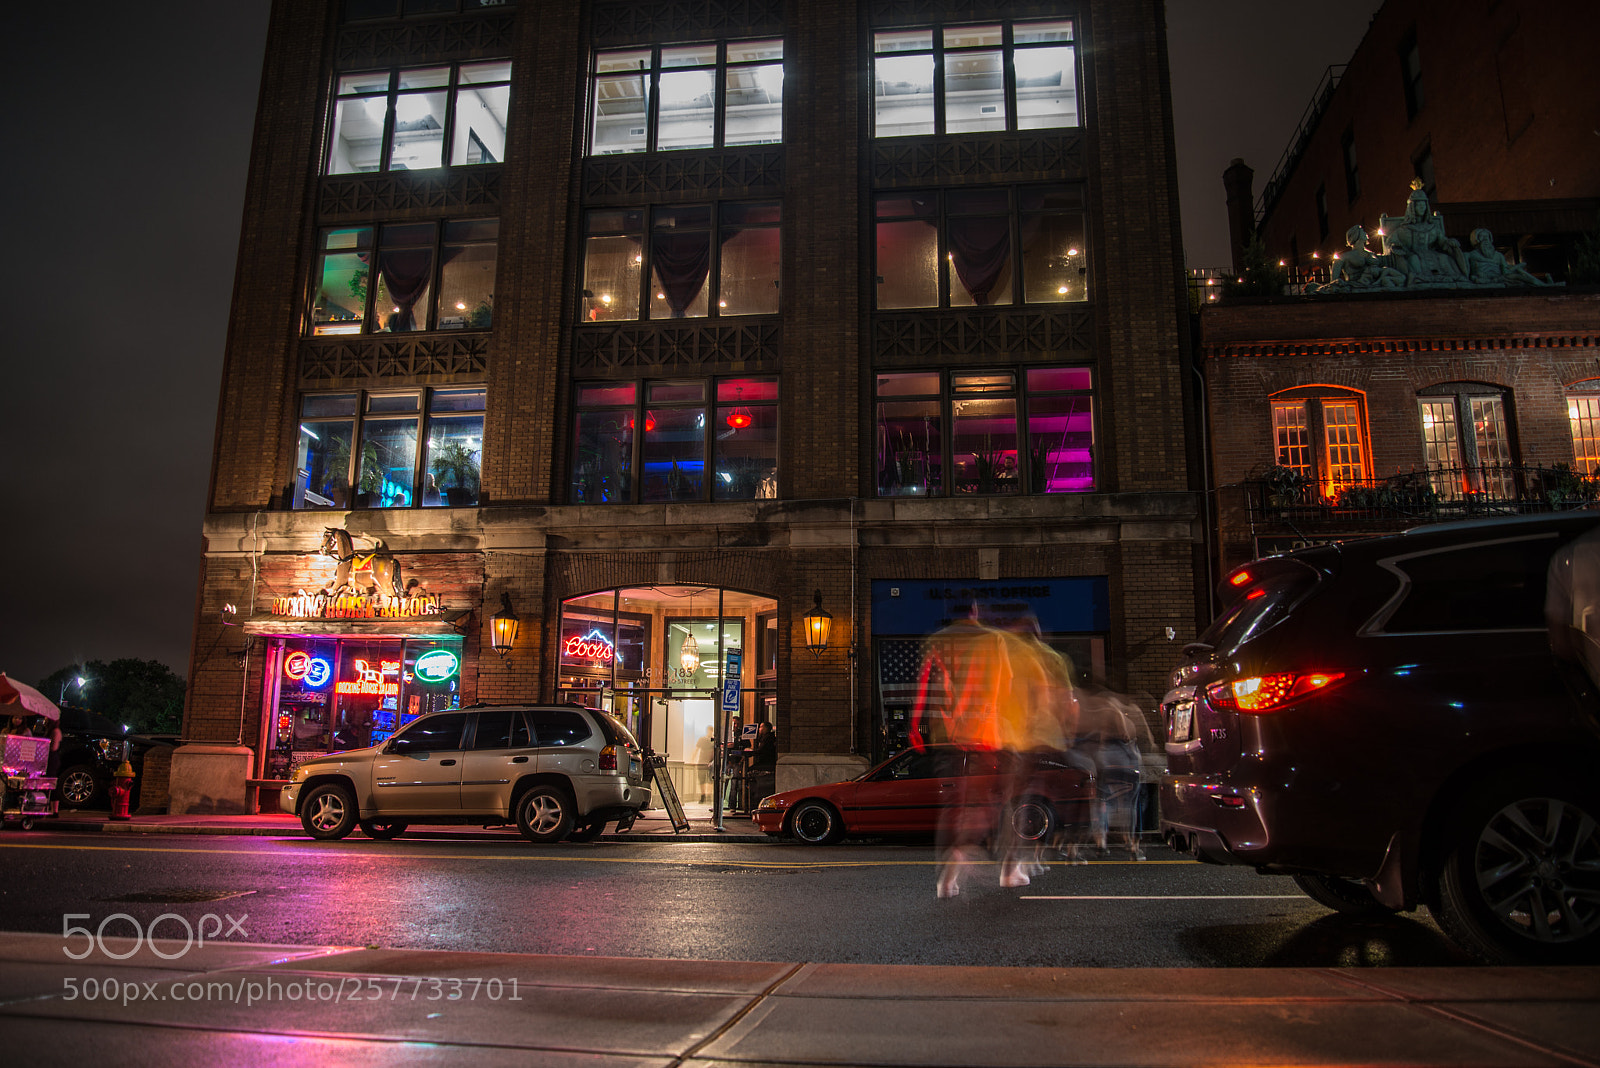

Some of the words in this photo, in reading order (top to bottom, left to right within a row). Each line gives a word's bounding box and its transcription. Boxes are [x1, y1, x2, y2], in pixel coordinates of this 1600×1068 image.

[961, 587, 996, 599] POST
[1001, 586, 1050, 598] OFFICE
[271, 589, 324, 618] ROCKING
[325, 595, 375, 618] HORSE
[380, 593, 442, 618] SALOON
[565, 636, 614, 659] Coors
[673, 667, 693, 678] 185
